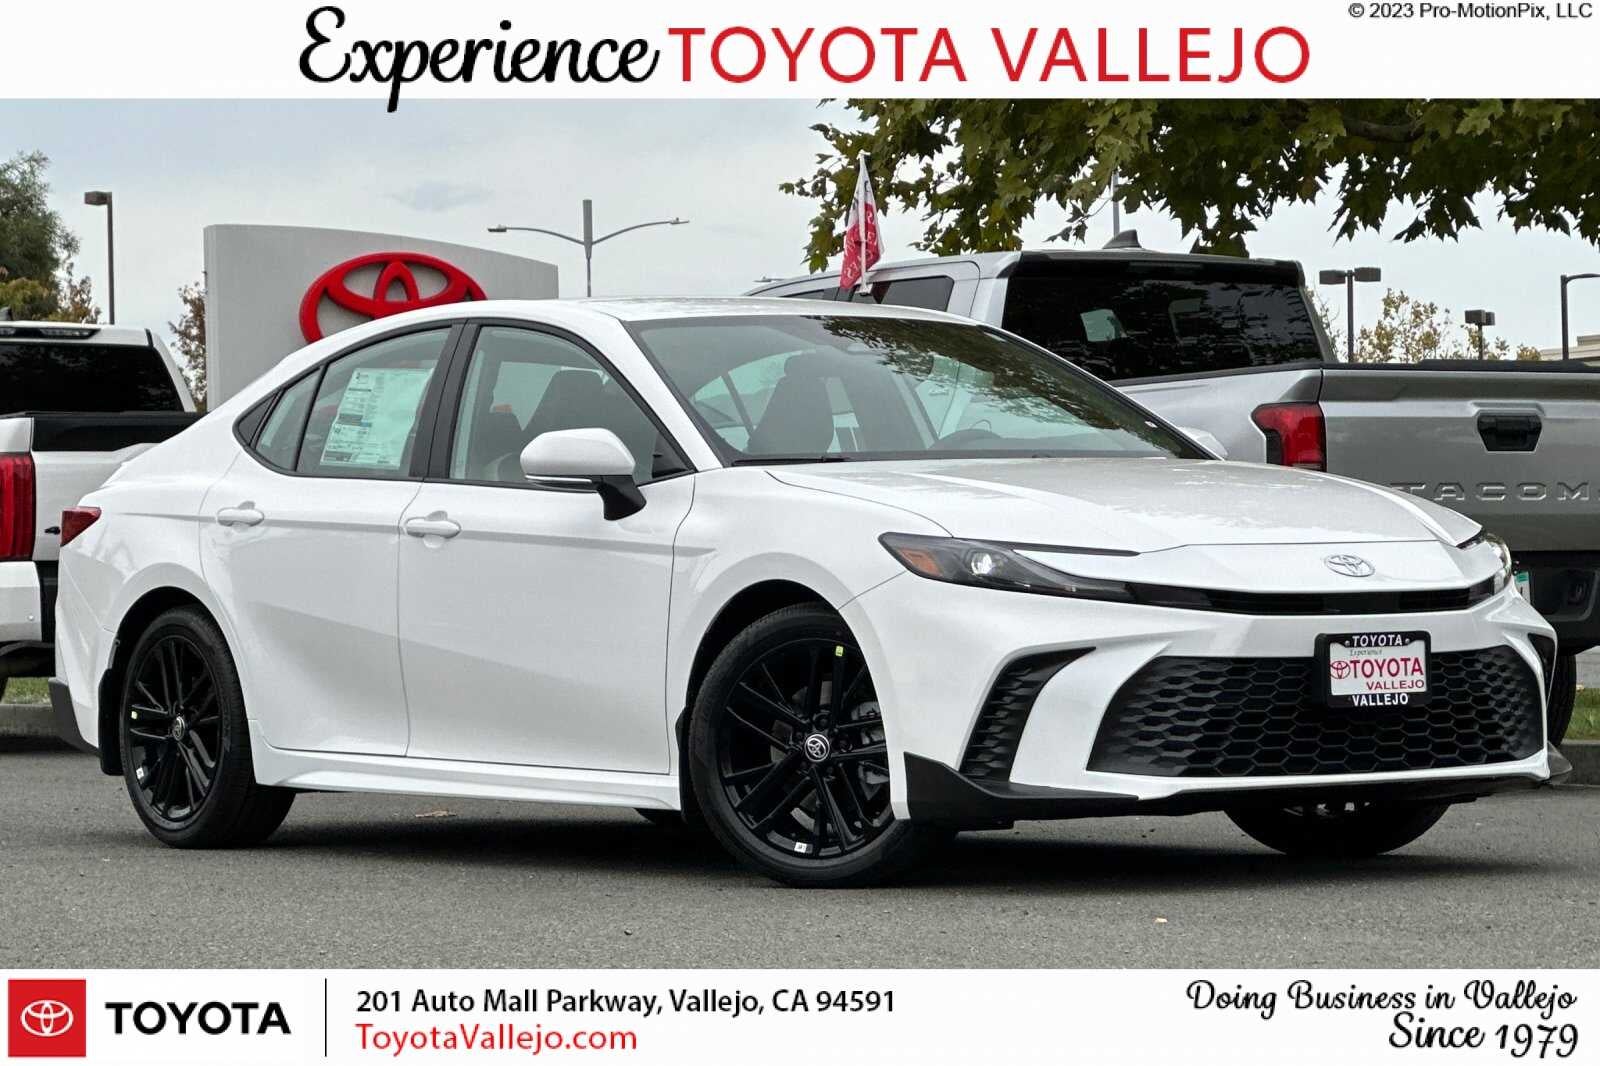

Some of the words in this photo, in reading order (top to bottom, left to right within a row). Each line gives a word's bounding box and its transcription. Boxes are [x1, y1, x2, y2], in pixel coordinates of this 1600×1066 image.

[1388, 481, 1600, 501] TACOM
[1352, 634, 1403, 647] TOYOTA
[1350, 657, 1424, 679] TOYOTA
[1366, 680, 1425, 691] VALLEJO
[1352, 693, 1409, 707] VALLEJO
